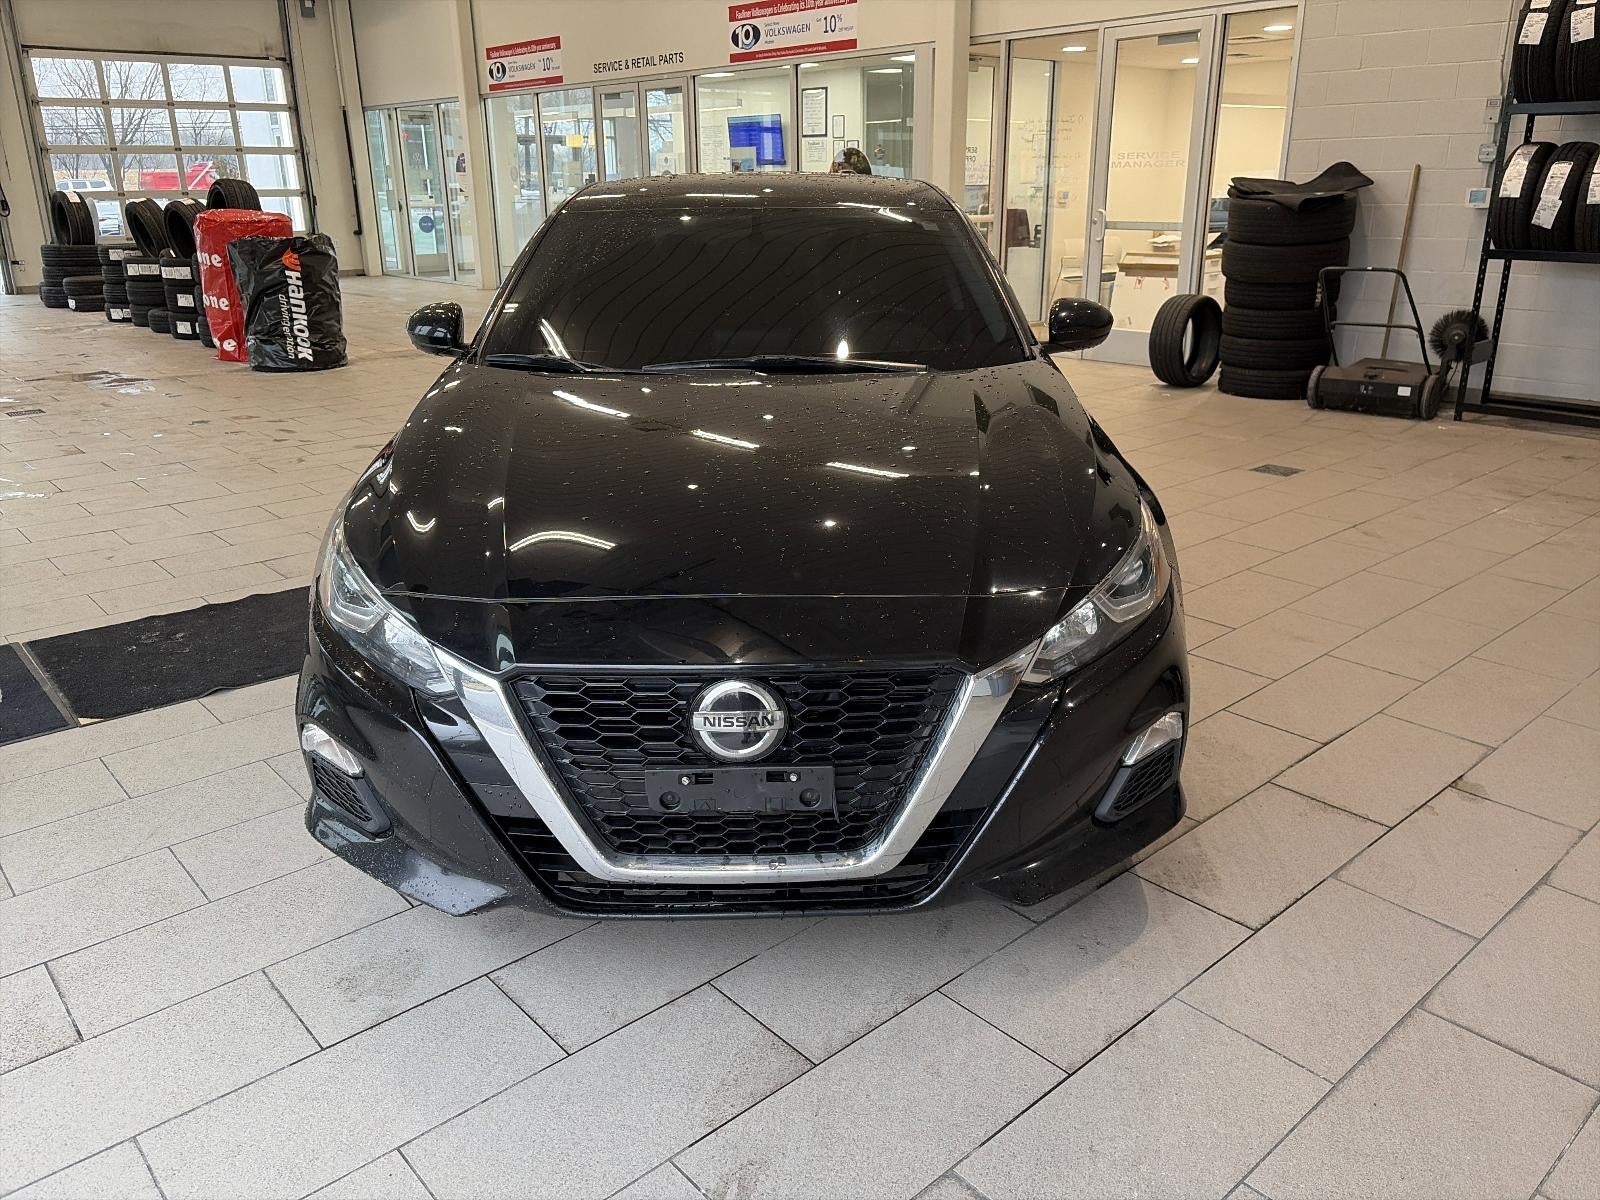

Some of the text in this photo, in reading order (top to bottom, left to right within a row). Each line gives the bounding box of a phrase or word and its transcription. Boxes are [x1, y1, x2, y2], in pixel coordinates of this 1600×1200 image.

[736, 9, 752, 19] Faulkner
[752, 6, 773, 17] Volkswagen
[773, 4, 778, 14] is
[778, 1, 800, 13] Celebrating
[764, 23, 811, 38] VOLKSWAGEN
[508, 62, 536, 73] VOLKSWAGEN
[593, 51, 684, 74] SERVICE & RETAIL PARTS
[1117, 151, 1181, 160] SERVICE
[1111, 160, 1185, 169] MANAGER
[278, 294, 291, 325] driving
[703, 716, 775, 728] NISSAN
